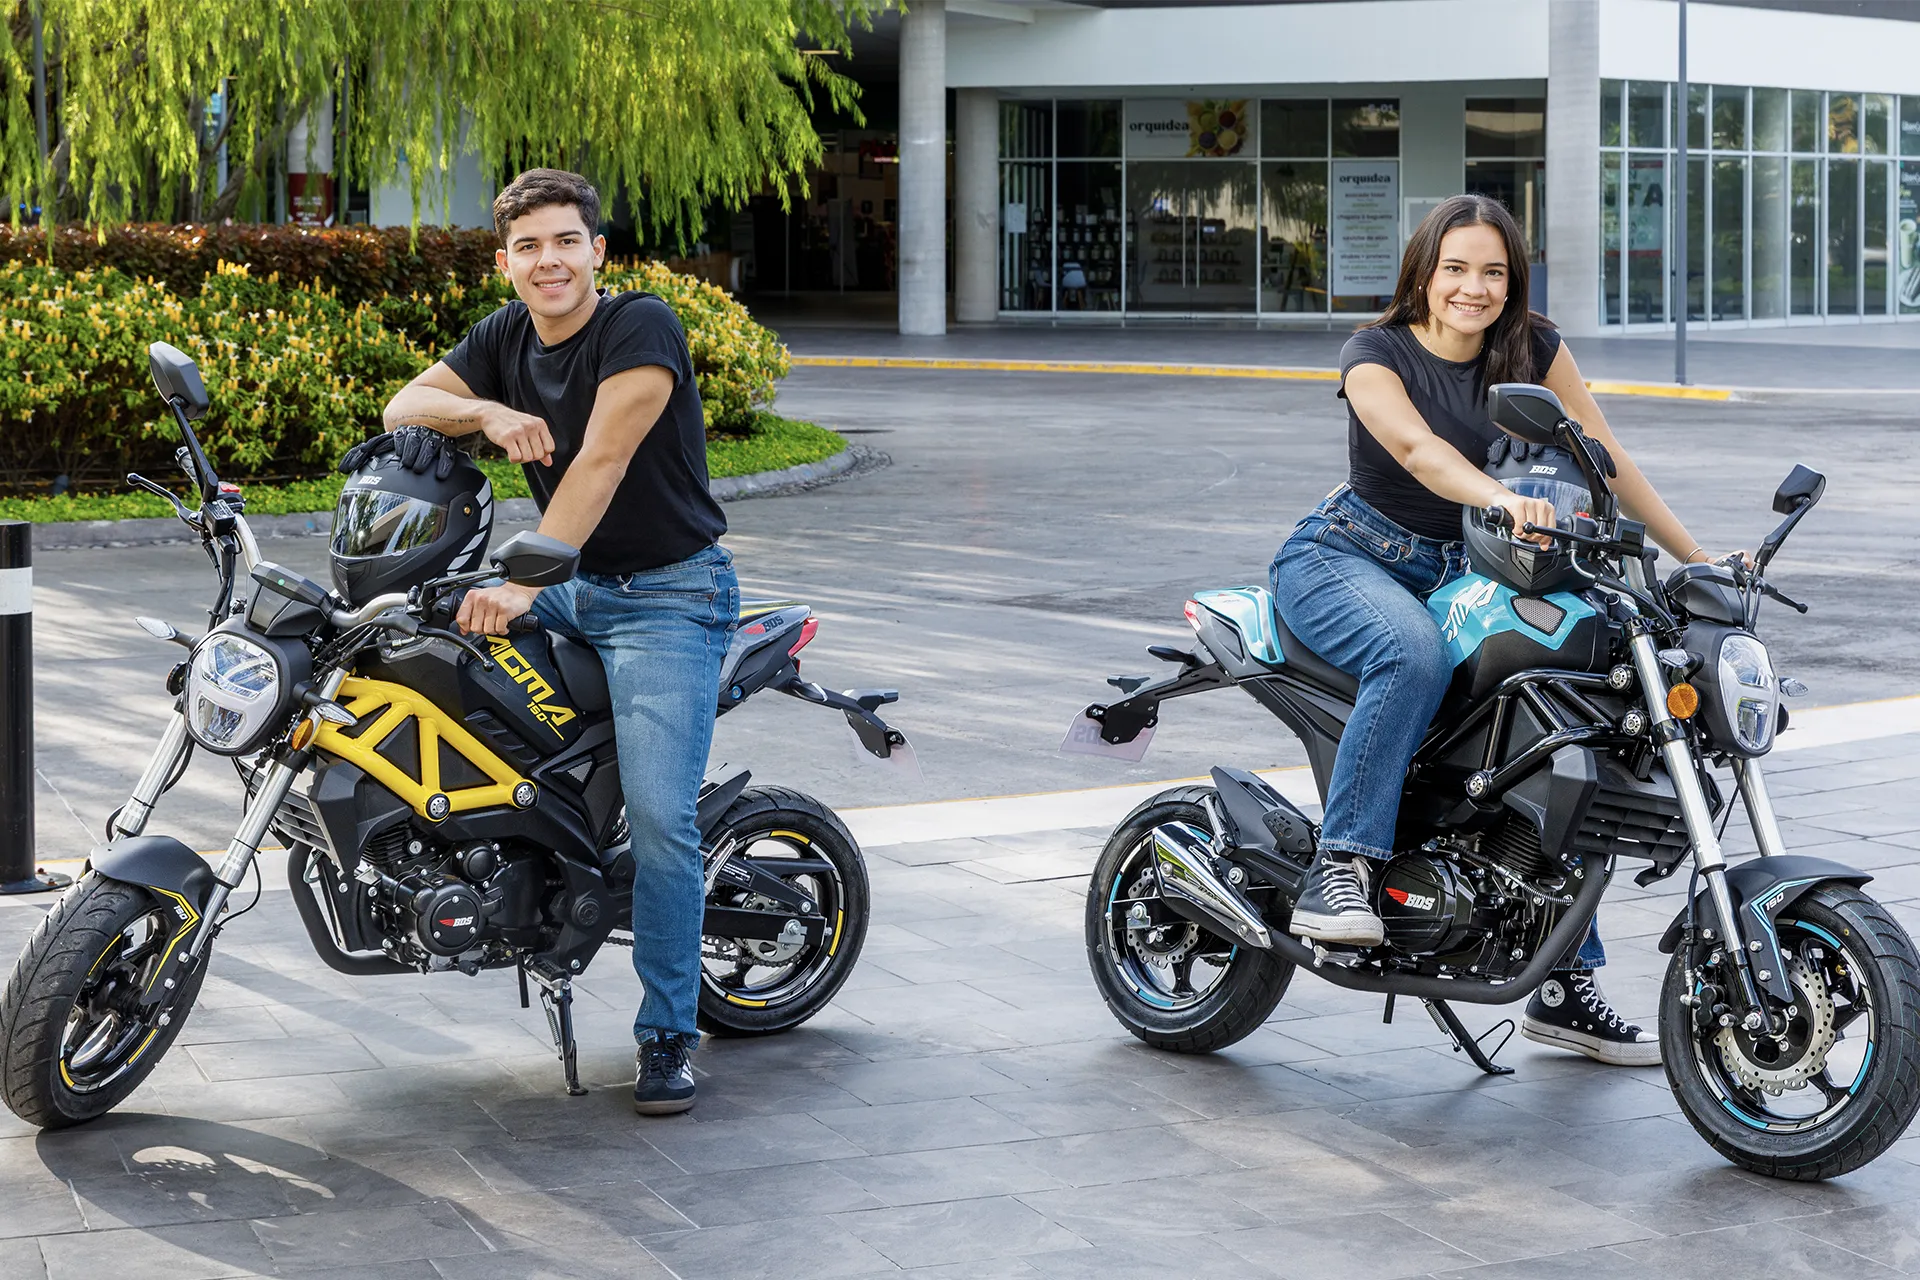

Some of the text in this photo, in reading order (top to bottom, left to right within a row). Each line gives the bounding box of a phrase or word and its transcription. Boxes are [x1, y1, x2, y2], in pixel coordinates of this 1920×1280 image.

[1529, 465, 1558, 475] BDS
[764, 615, 785, 632] BDS
[486, 635, 577, 727] AGMA
[526, 701, 548, 722] 150
[1404, 893, 1436, 911] BDS
[1765, 892, 1785, 911] 150
[173, 904, 189, 920] 150
[452, 916, 474, 927] BDS
